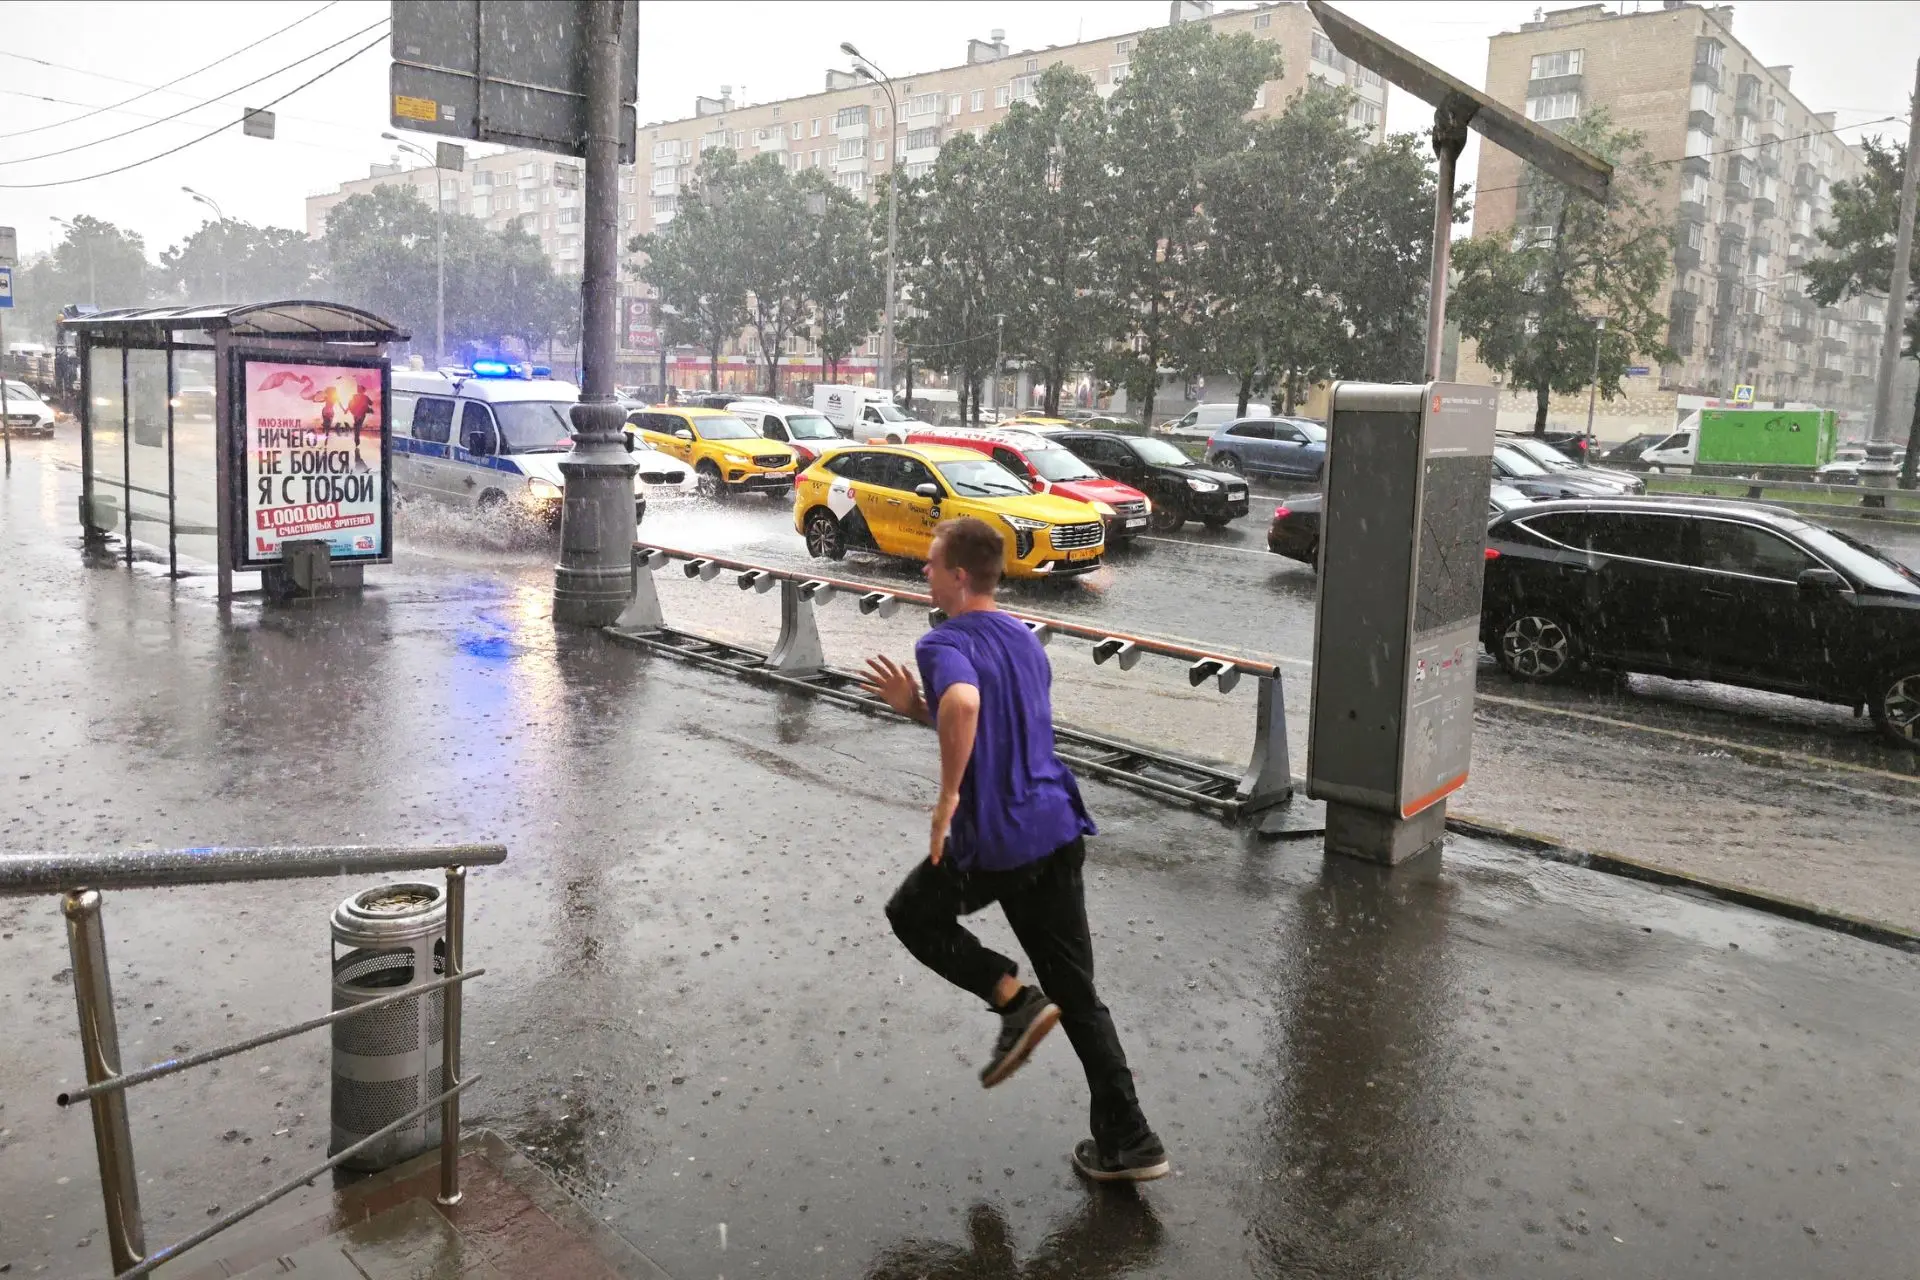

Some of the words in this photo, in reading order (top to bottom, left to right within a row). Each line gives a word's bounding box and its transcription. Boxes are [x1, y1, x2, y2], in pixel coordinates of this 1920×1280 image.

[258, 418, 301, 428] МЮЗИКЛ
[258, 428, 318, 448] НИЧЕГО
[258, 450, 282, 475] НЕ
[258, 476, 272, 505] Я
[281, 475, 295, 504] С
[930, 508, 940, 518] Go
[279, 521, 332, 536] СЧАСТЛИВЫХ
